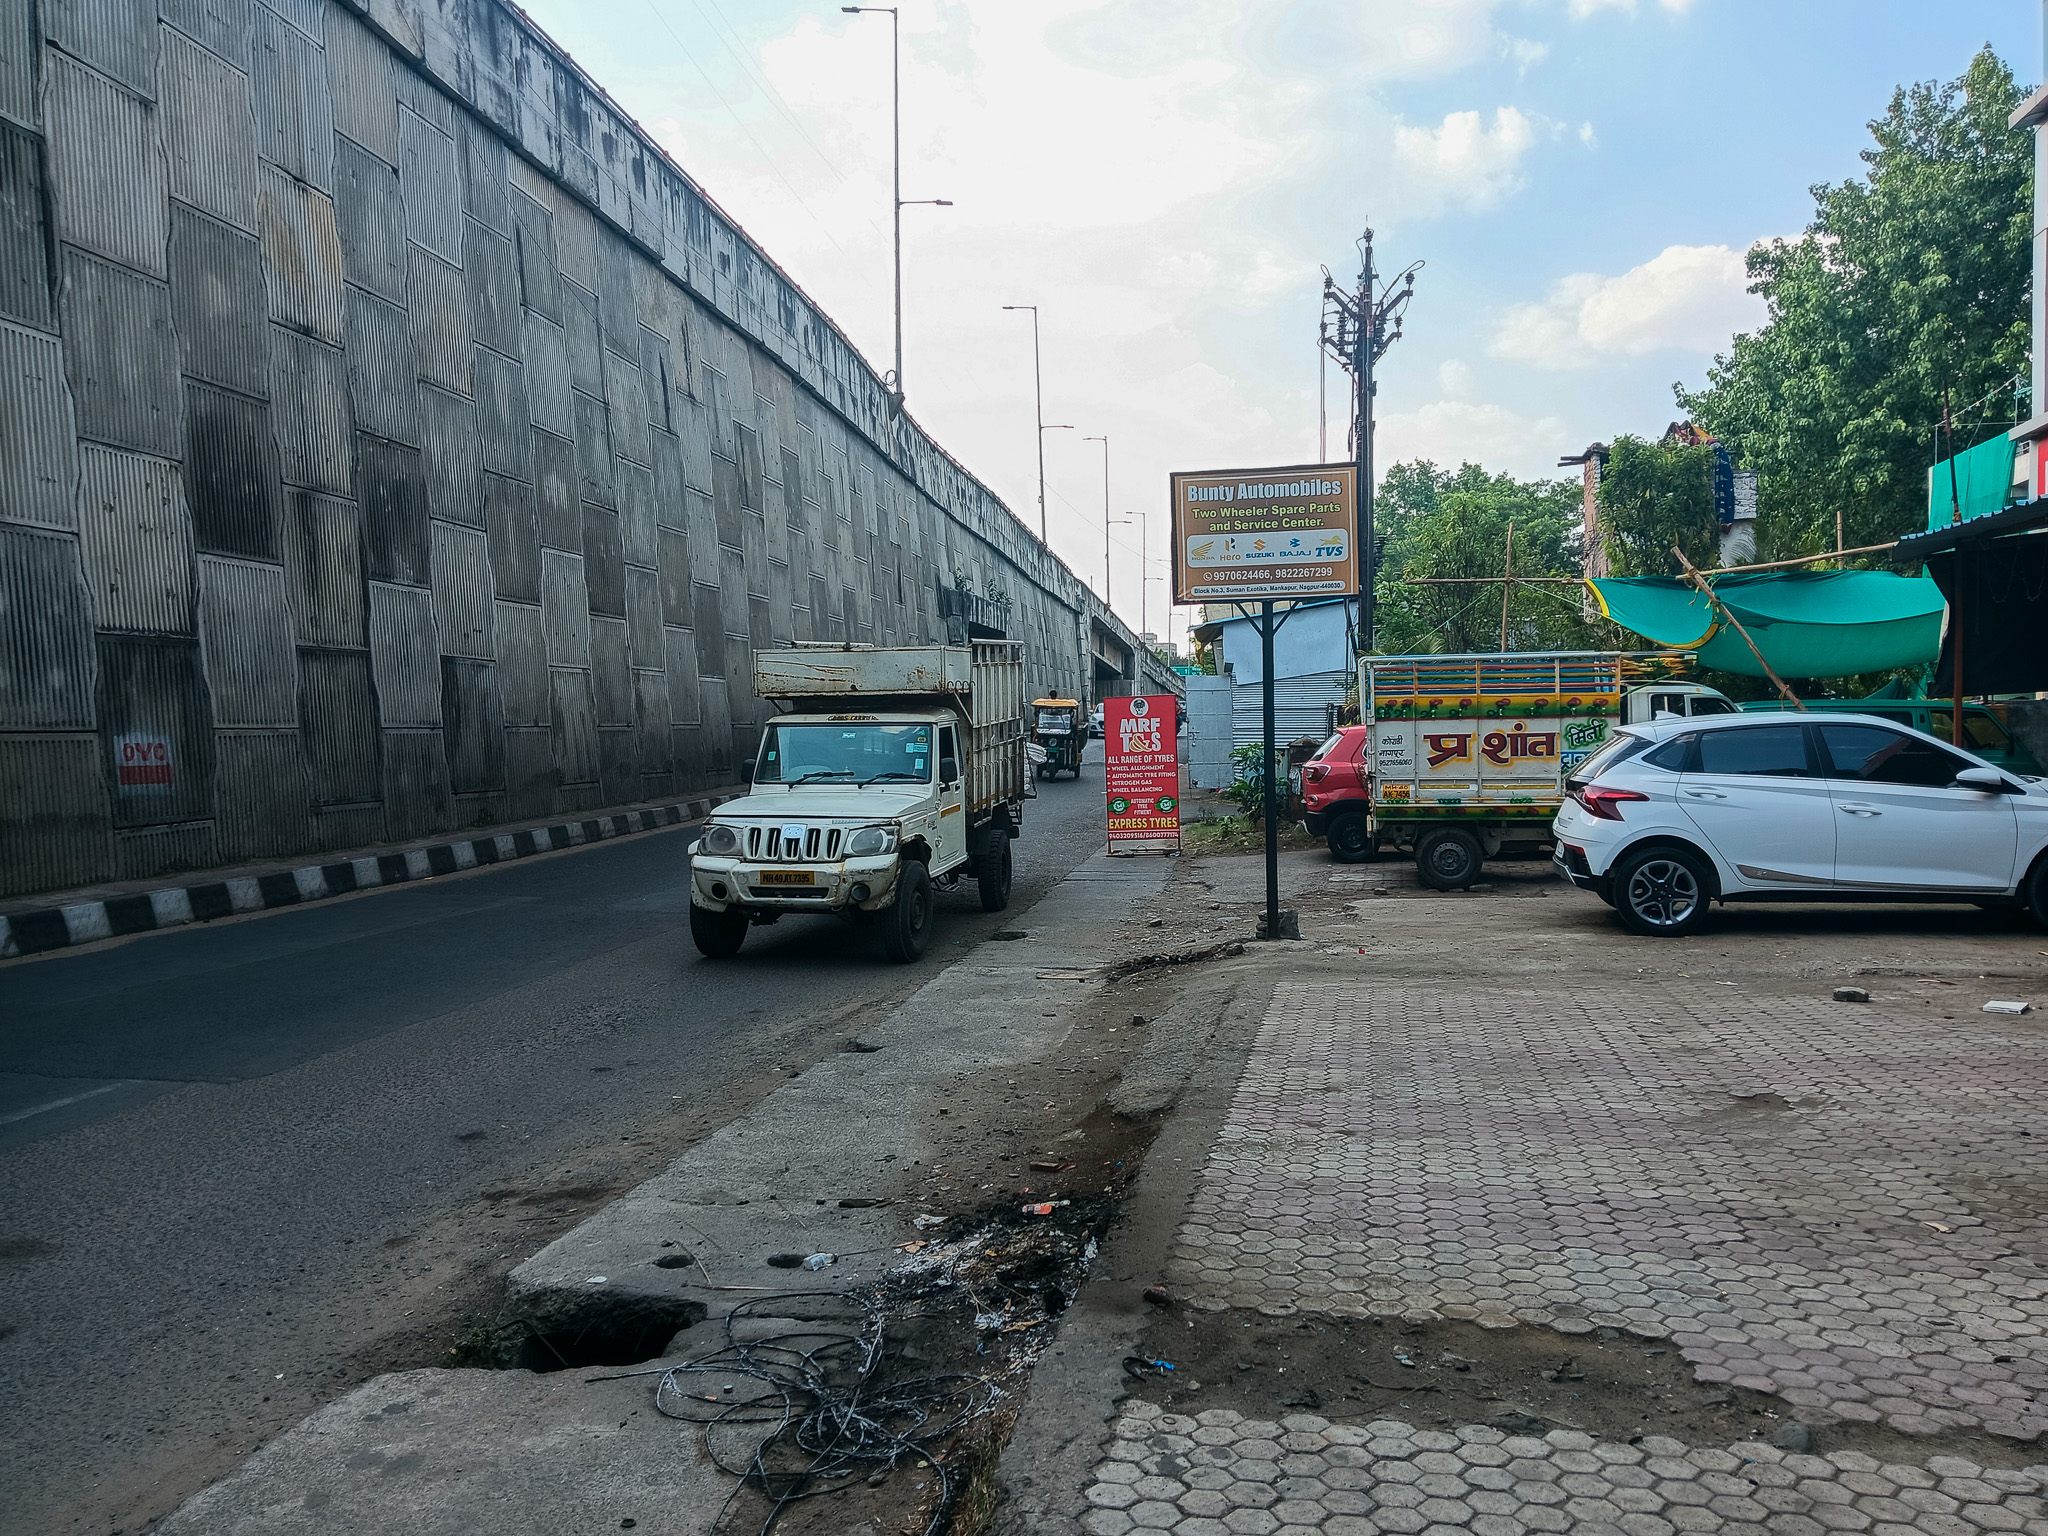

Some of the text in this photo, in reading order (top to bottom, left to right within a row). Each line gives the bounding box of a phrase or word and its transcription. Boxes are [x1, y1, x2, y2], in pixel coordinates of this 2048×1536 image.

[1187, 479, 1342, 502] Bunty Automobiles
[1192, 502, 1341, 519] Two Wheeler Spare Parts
[1209, 517, 1325, 531] and Service Center.
[1315, 546, 1344, 557] TVS
[1213, 566, 1333, 582] 9970624466, 9822267299
[1269, 584, 1299, 592] Mankapur,
[1120, 718, 1161, 733] MRF
[1568, 718, 1604, 747] मिनी
[1119, 732, 1162, 753] T&S
[122, 742, 165, 762] OYO
[1107, 754, 1175, 764] ALL RANGE OF TYRES
[1108, 817, 1178, 829] EXPRESS TYRES
